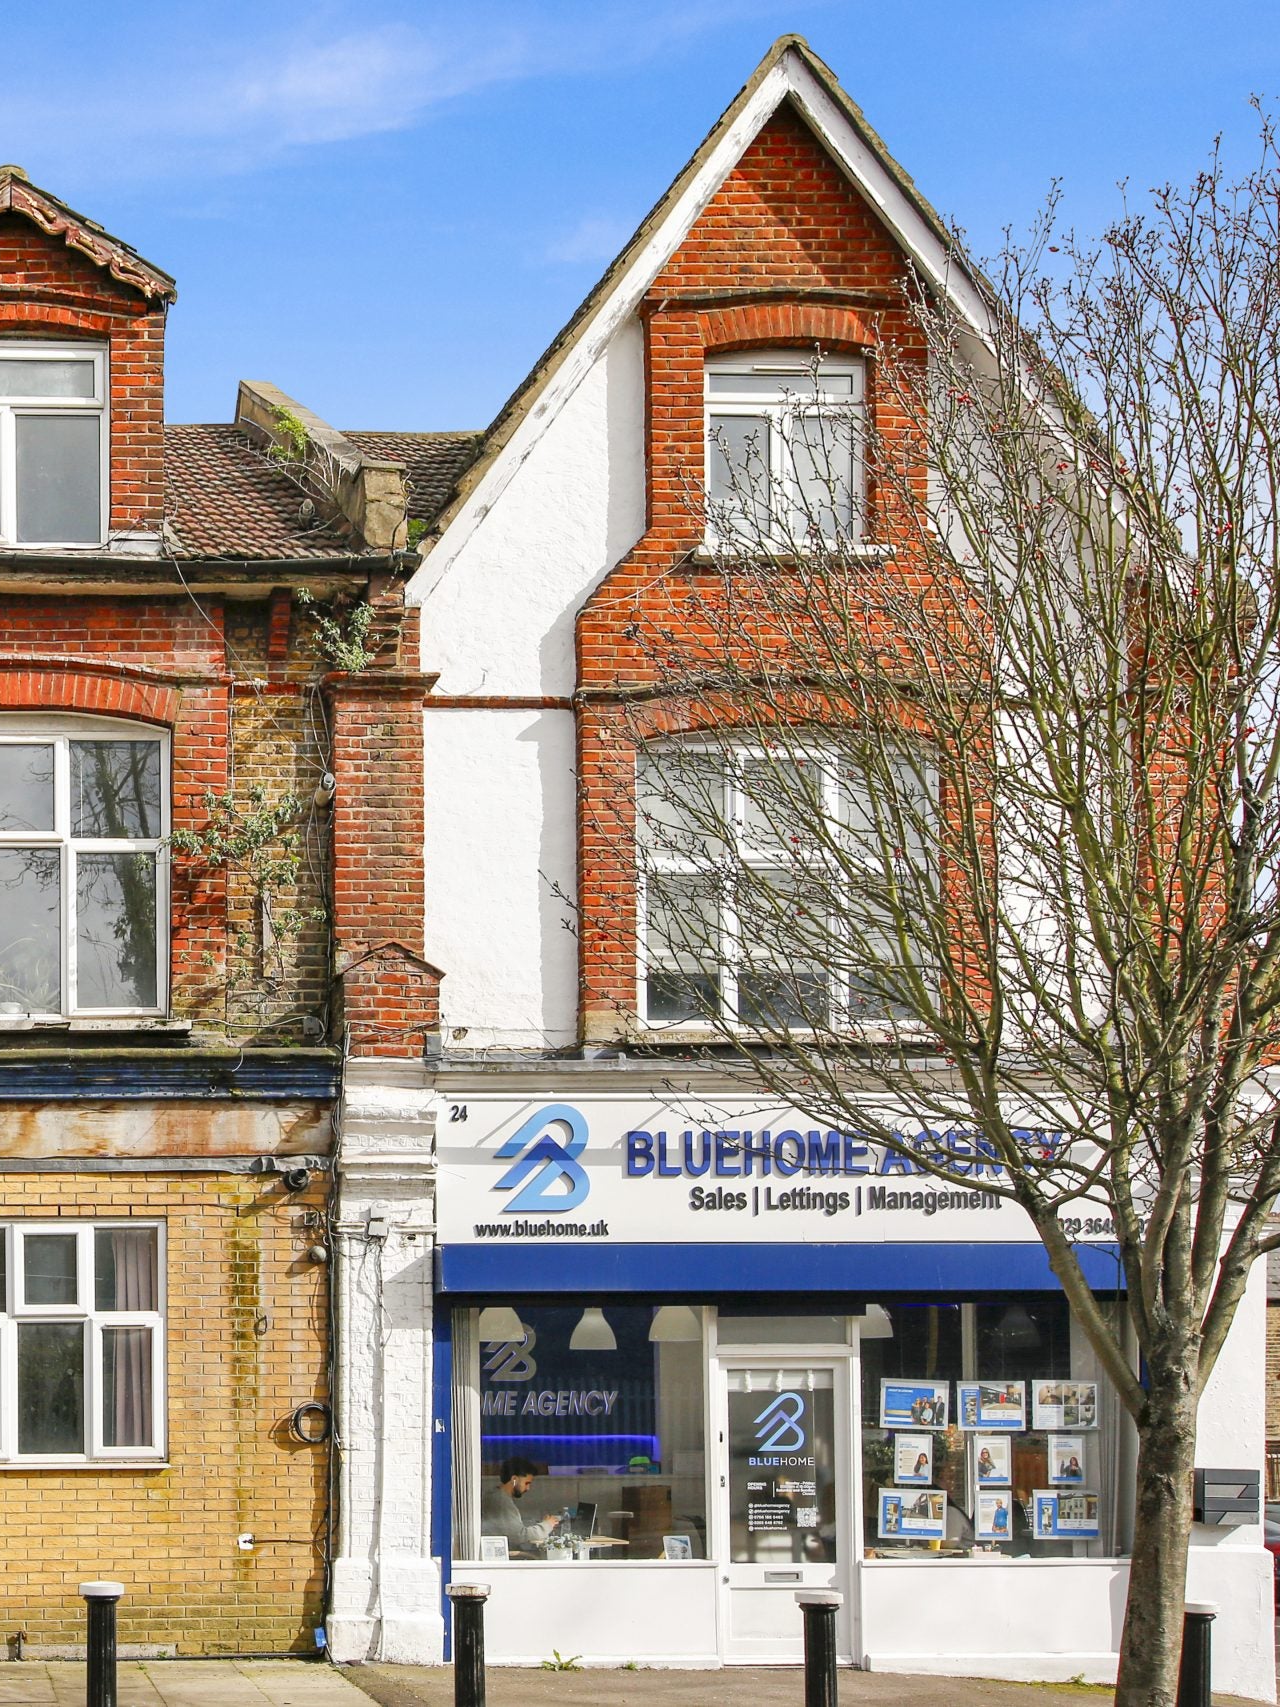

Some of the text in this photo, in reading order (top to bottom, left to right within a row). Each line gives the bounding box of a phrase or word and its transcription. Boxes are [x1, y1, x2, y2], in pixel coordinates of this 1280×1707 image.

[449, 1105, 468, 1122] 24
[627, 1129, 870, 1176] BLUEHOME
[689, 1185, 1002, 1217] Sales Lettings Management
[473, 1219, 609, 1238] www.bluehome.uk
[520, 1390, 619, 1416] AGENCY
[748, 1457, 815, 1466] BLUEHOME
